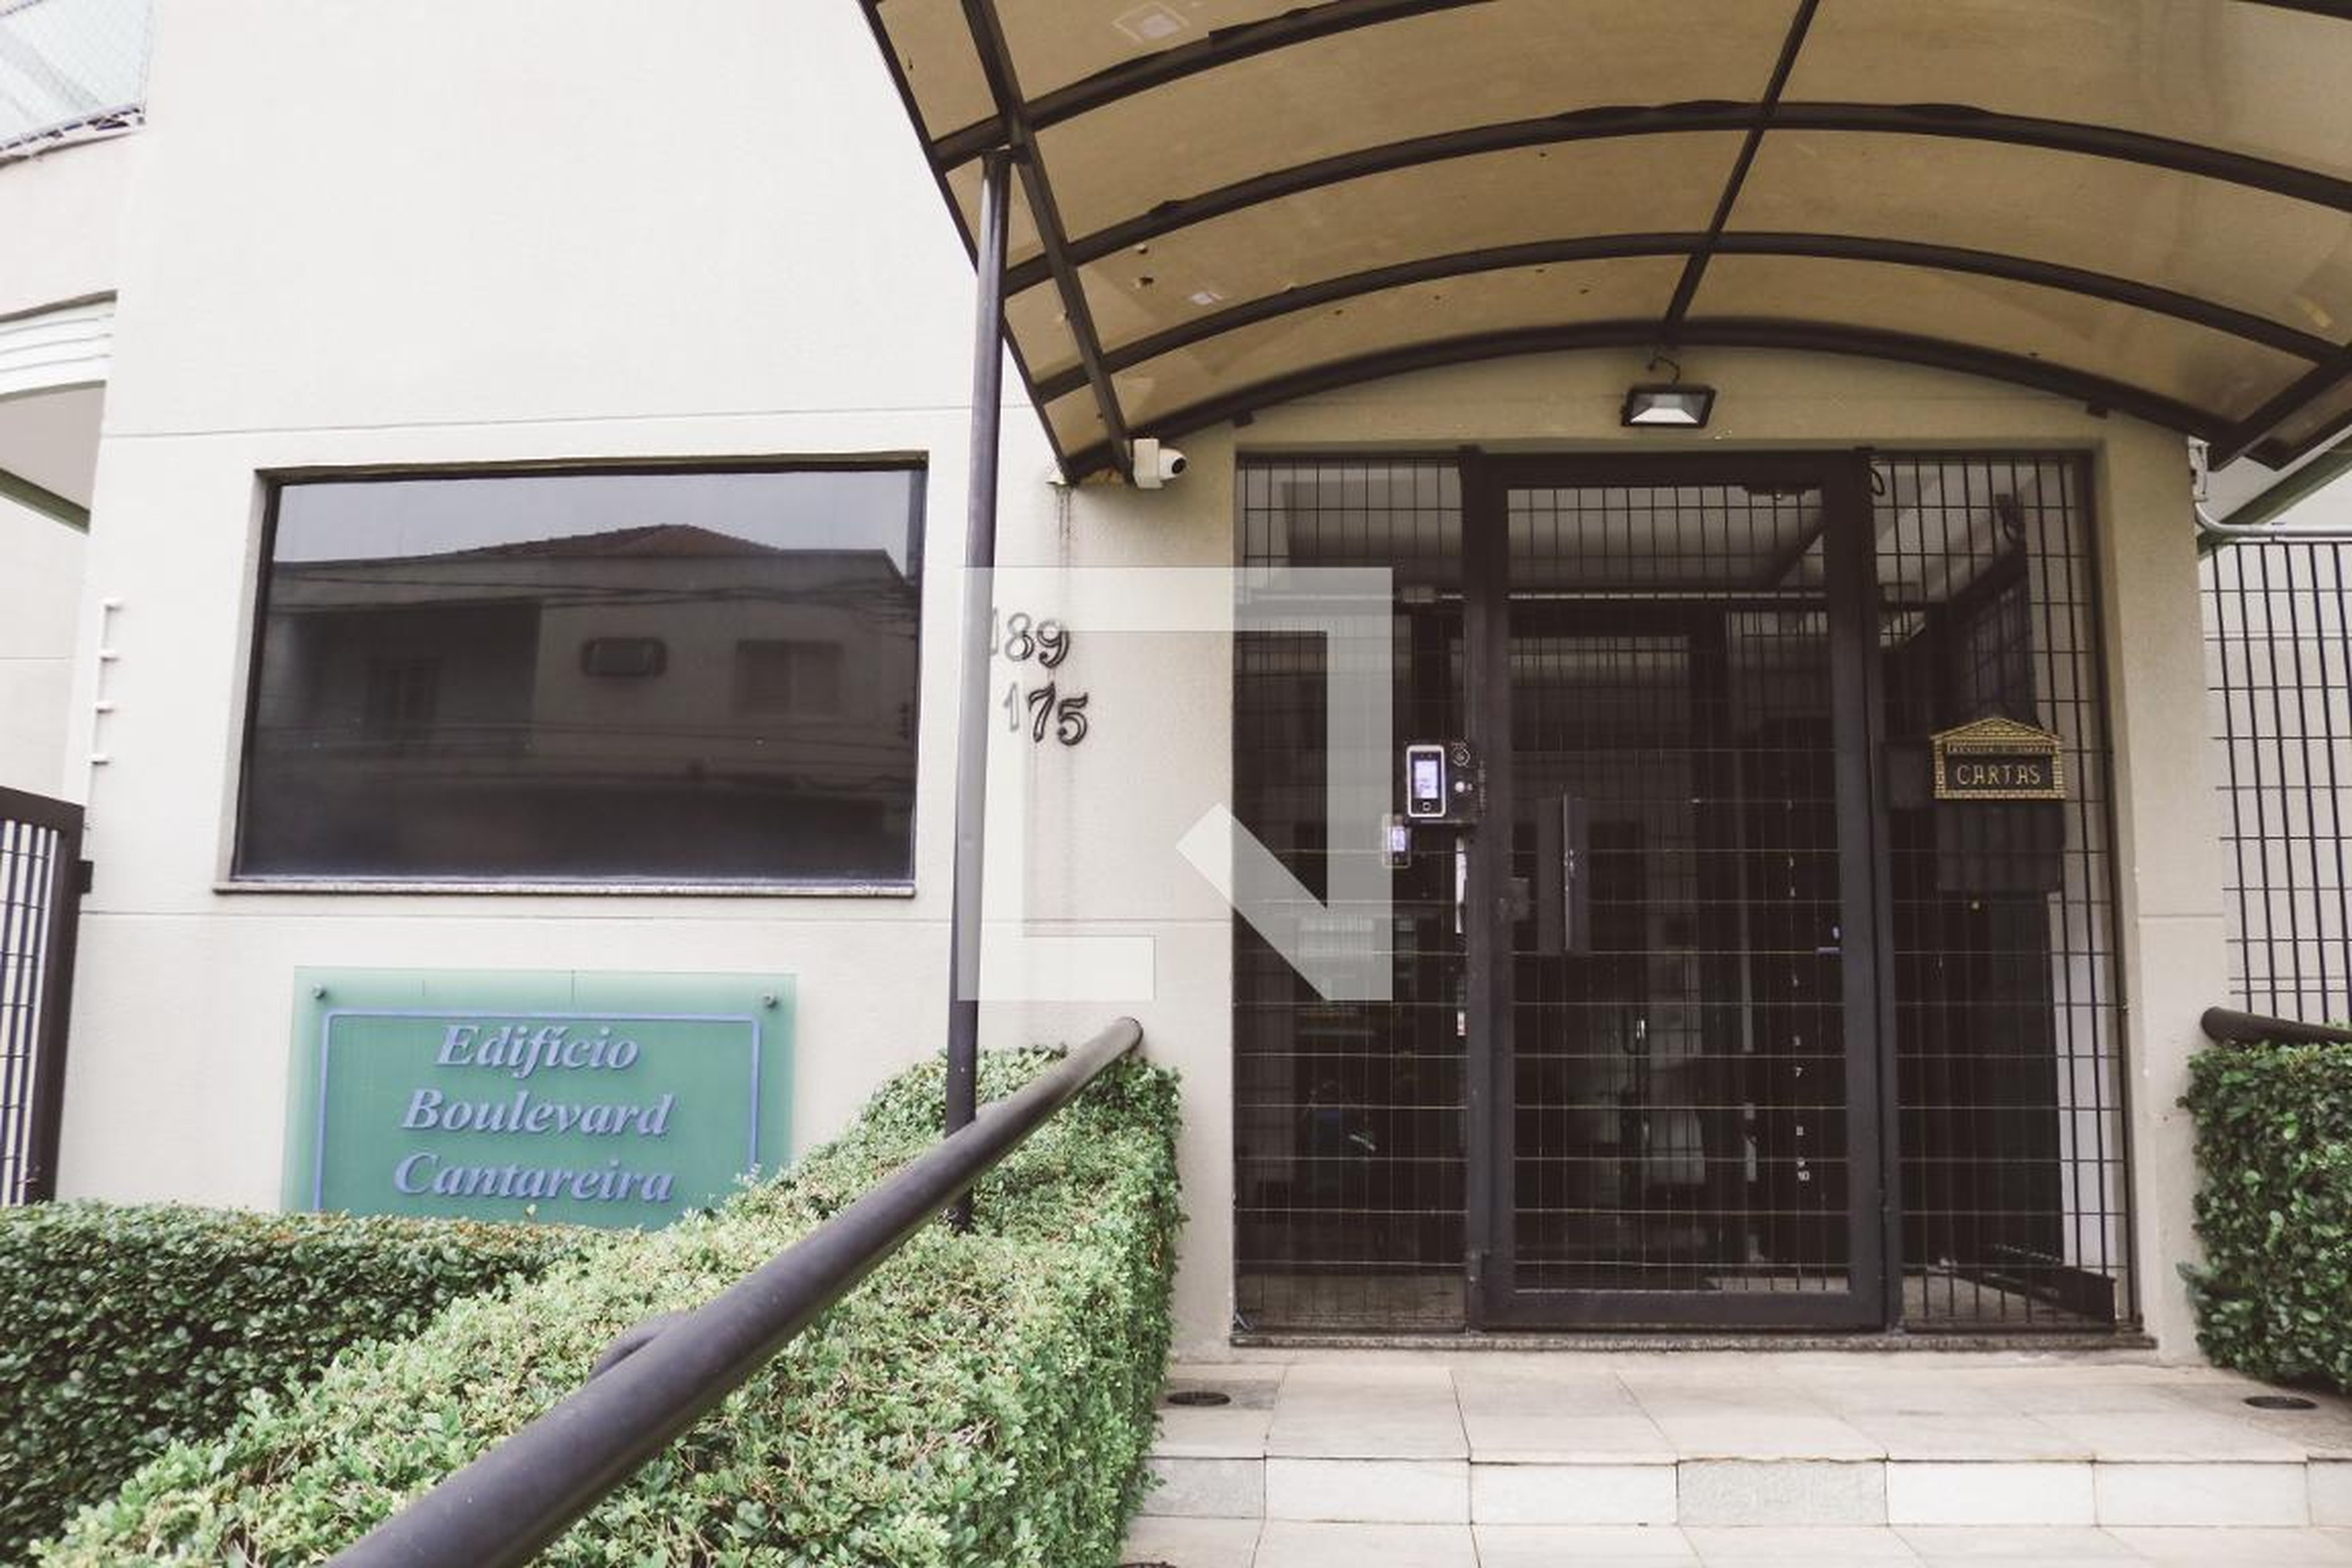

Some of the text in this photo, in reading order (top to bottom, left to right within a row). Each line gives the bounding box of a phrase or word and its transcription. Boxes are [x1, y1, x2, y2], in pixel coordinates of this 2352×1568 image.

[1003, 681, 1088, 745] 175
[1957, 765, 2041, 785] CARTAS
[434, 1025, 640, 1079] Edifício
[399, 1088, 676, 1137] Boulevard
[393, 1150, 675, 1203] Cantareira
